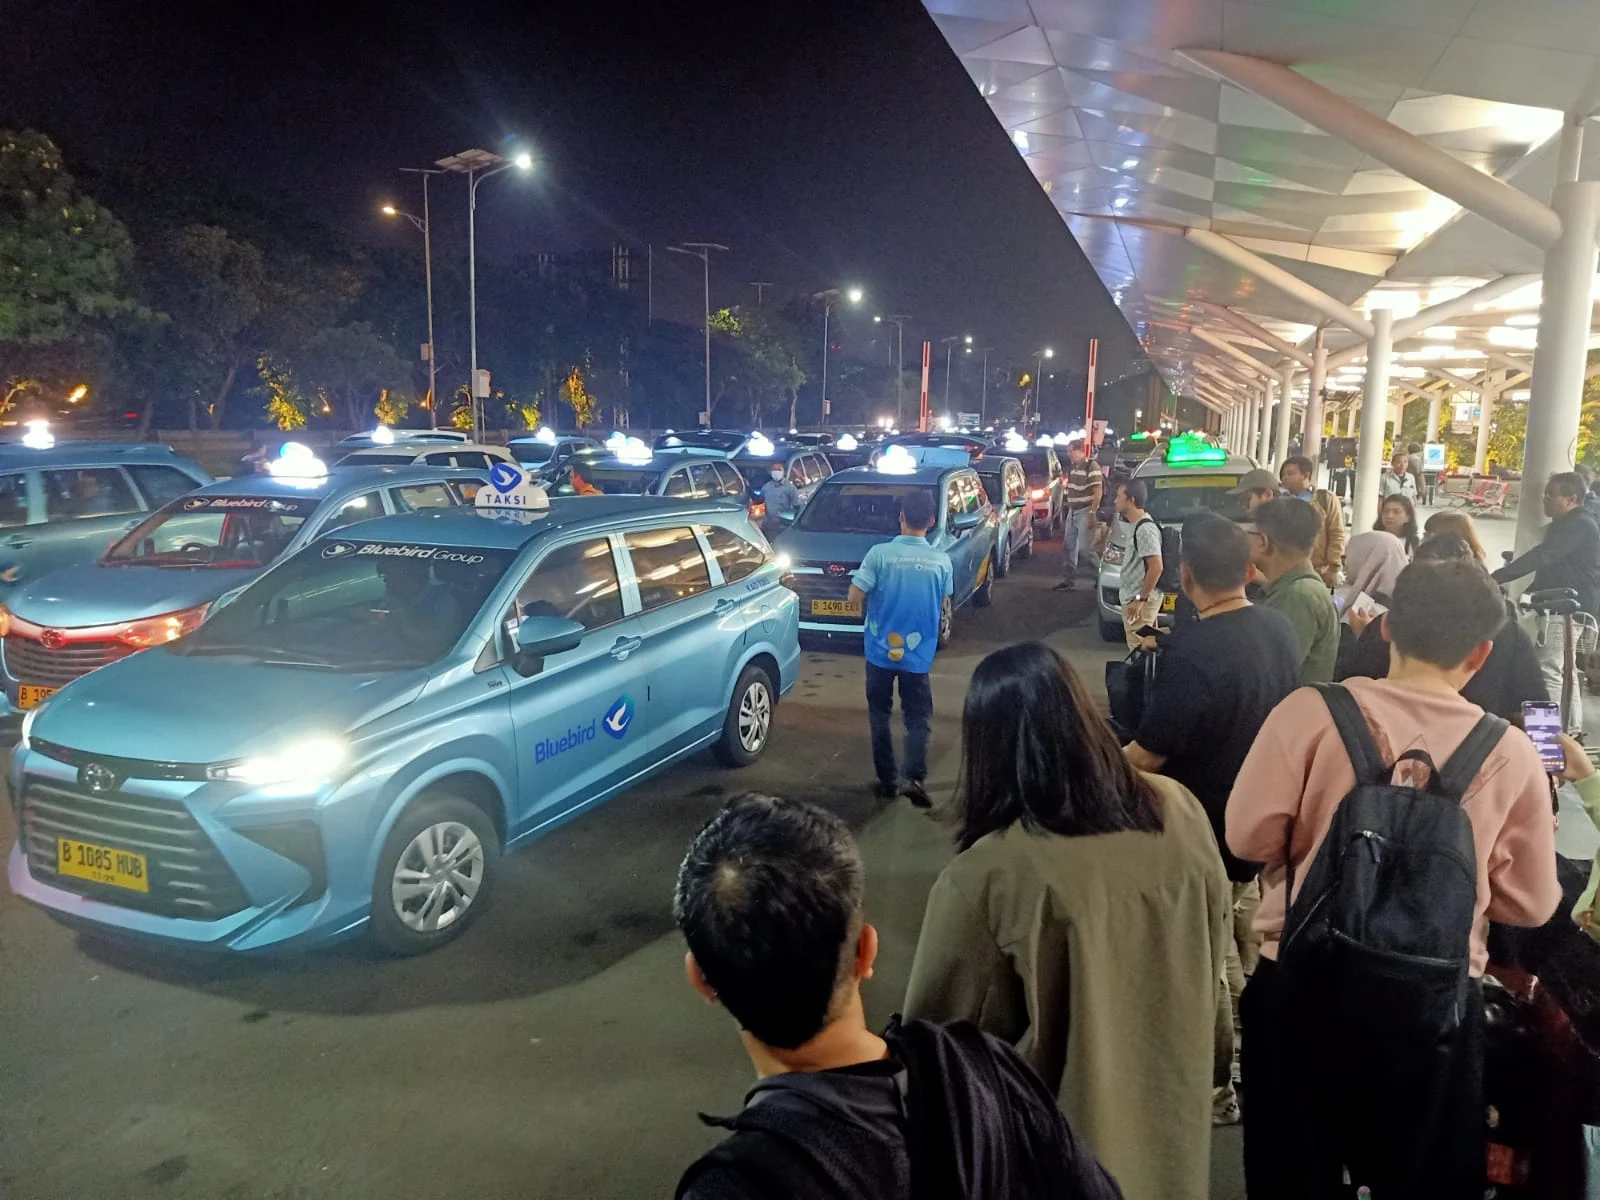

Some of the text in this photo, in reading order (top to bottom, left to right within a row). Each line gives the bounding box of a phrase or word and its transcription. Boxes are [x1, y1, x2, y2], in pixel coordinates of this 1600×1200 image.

[209, 499, 267, 508] Bluebird
[485, 494, 526, 505] TAKSI
[357, 544, 484, 565] Bluebird Group
[813, 600, 819, 610] B
[20, 687, 28, 700] B
[535, 718, 596, 765] Bluebird
[62, 841, 72, 863] B
[77, 844, 113, 871] 1085
[116, 853, 143, 878] HUB
